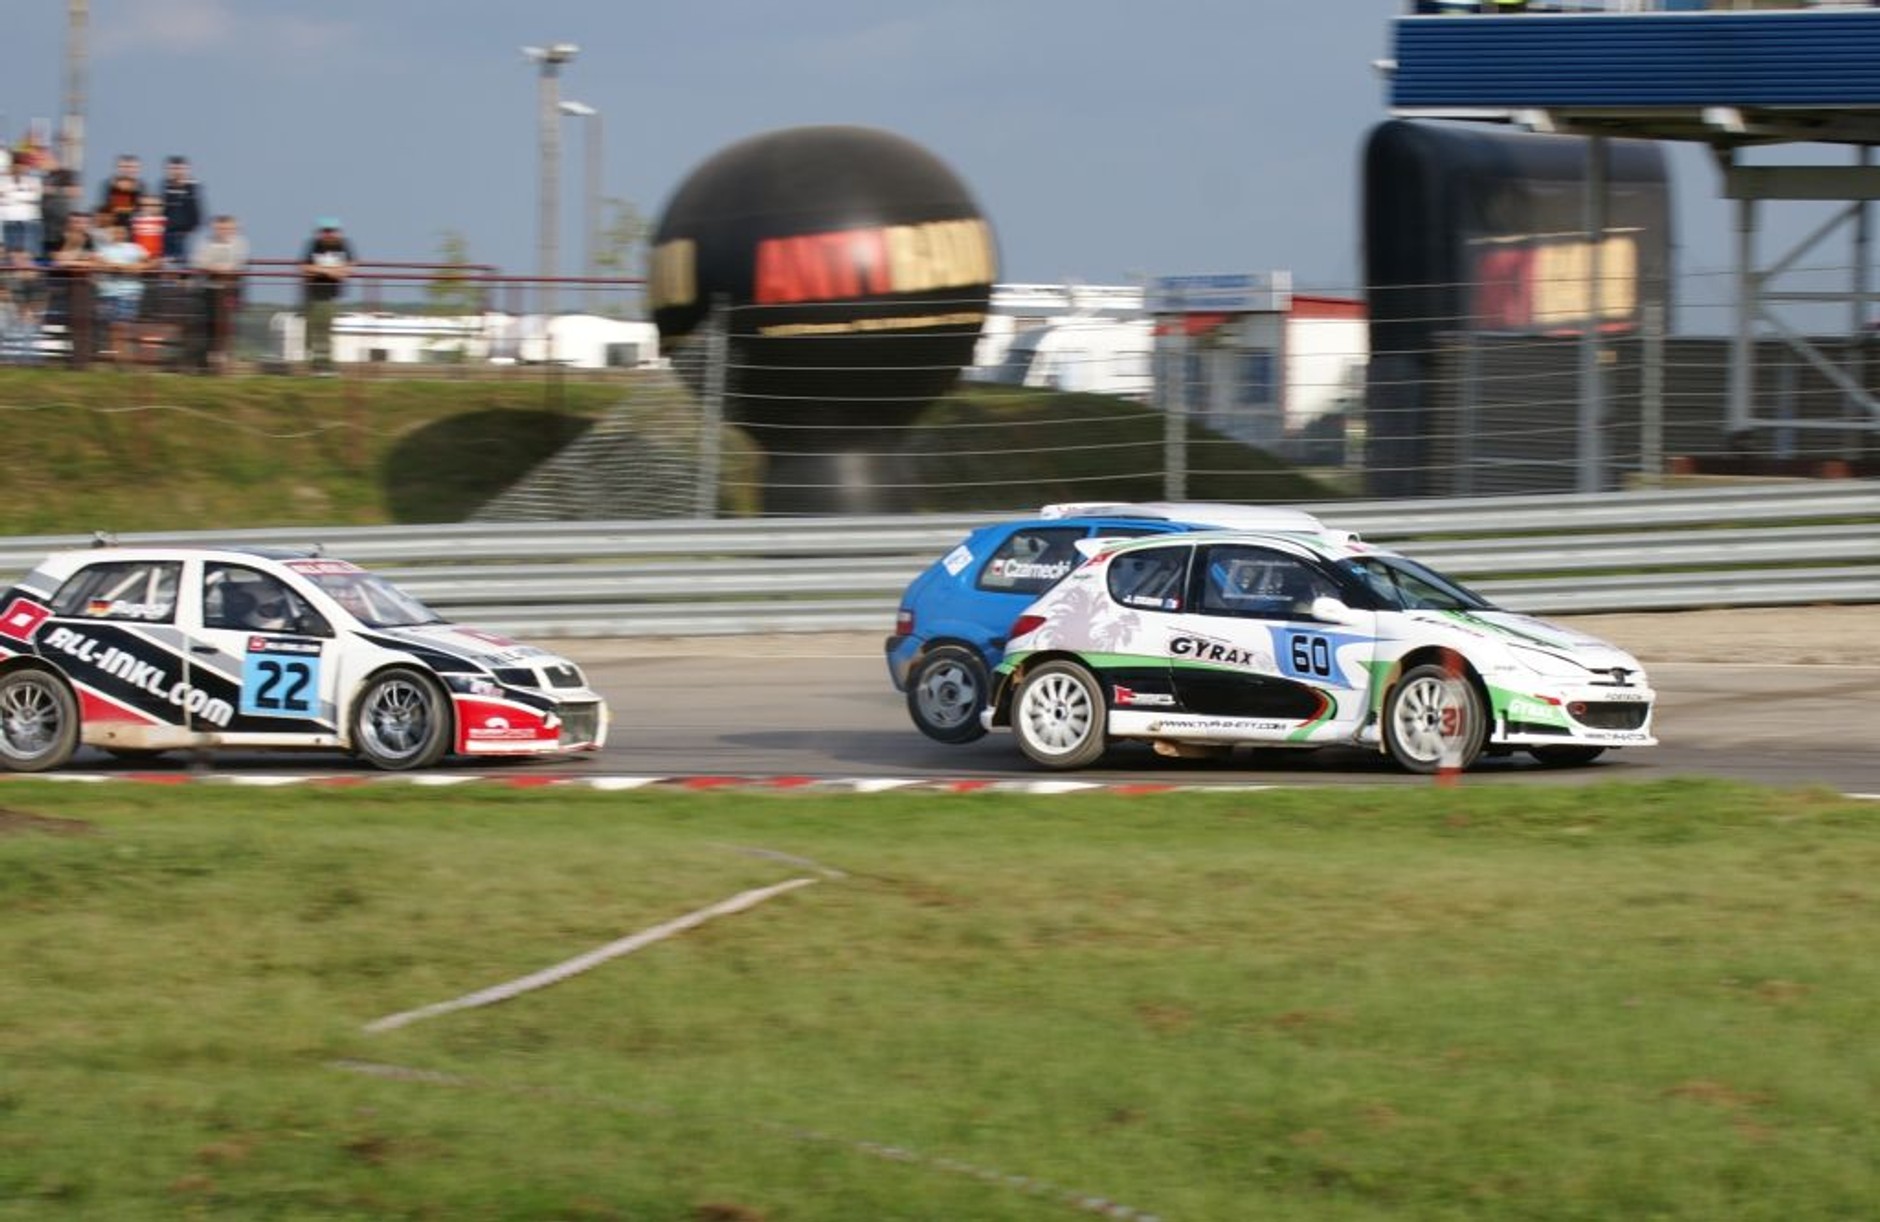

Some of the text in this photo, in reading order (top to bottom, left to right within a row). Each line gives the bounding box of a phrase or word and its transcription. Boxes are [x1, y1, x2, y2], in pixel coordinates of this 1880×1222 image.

[1169, 636, 1253, 666] GYRAX
[1291, 634, 1331, 677] 60
[255, 660, 311, 711] 22
